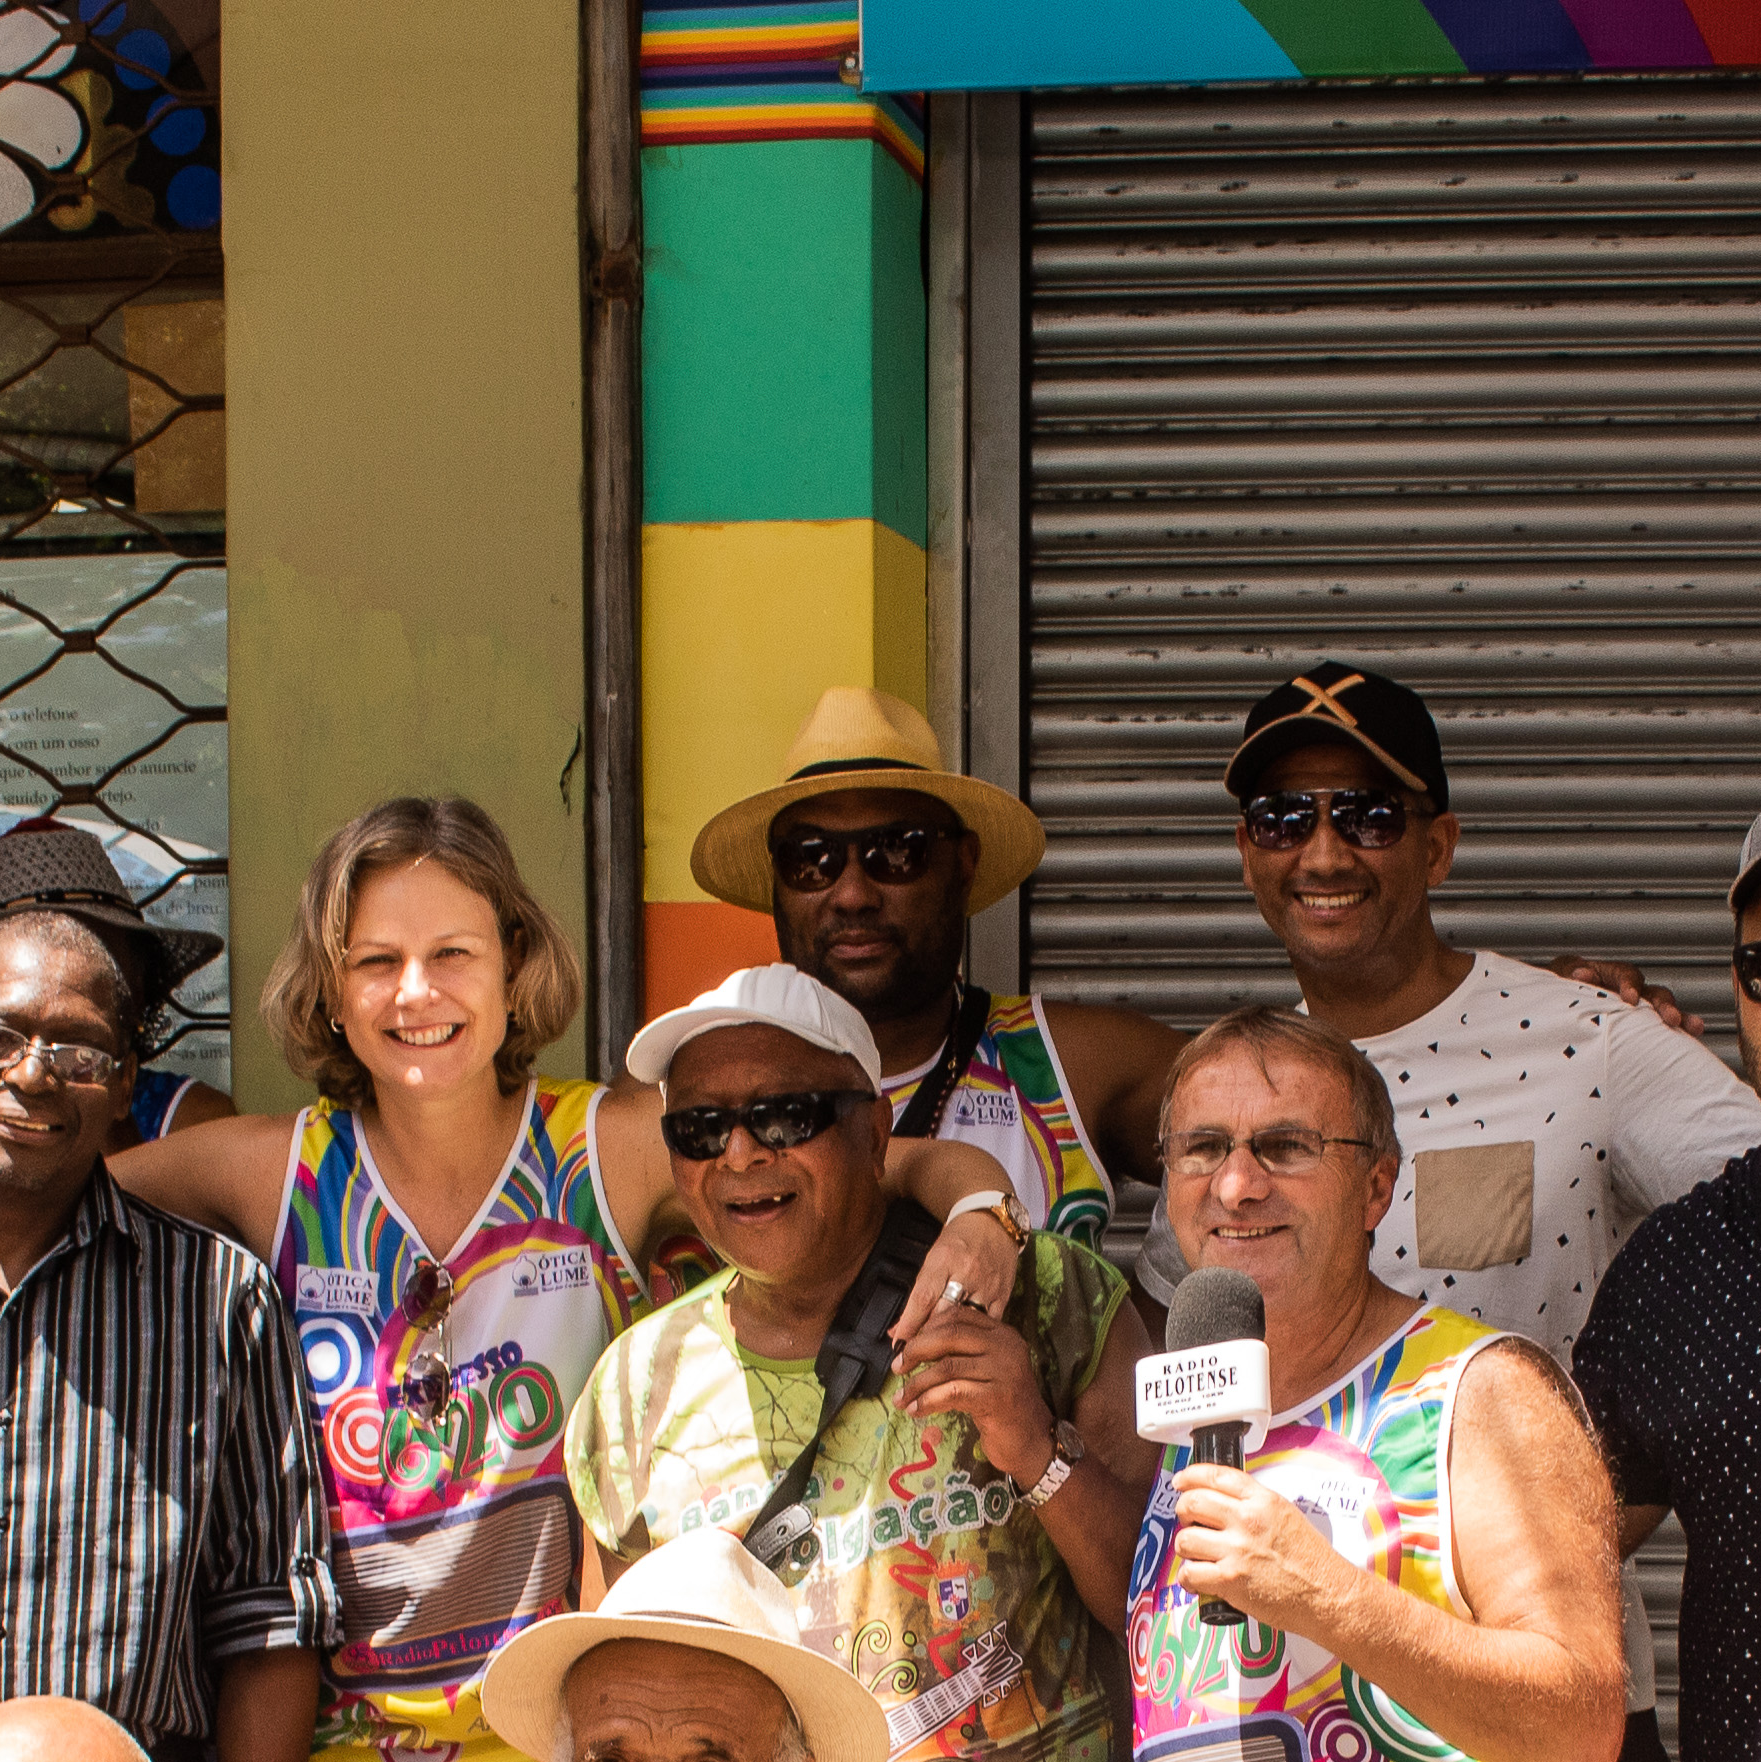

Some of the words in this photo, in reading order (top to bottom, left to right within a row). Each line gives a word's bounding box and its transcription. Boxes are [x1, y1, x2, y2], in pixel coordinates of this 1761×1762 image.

[538, 1250, 587, 1271] ÓTICA
[326, 1271, 373, 1291] ÓTICA
[539, 1266, 590, 1287] LUME
[326, 1290, 372, 1307] LUME
[384, 1340, 524, 1409] EESSO
[1163, 1354, 1219, 1375] RÁDIO
[1144, 1366, 1239, 1401] PELOTENSE
[377, 1360, 565, 1493] 620
[681, 1473, 823, 1534] Bana
[788, 1470, 1015, 1567] olgação
